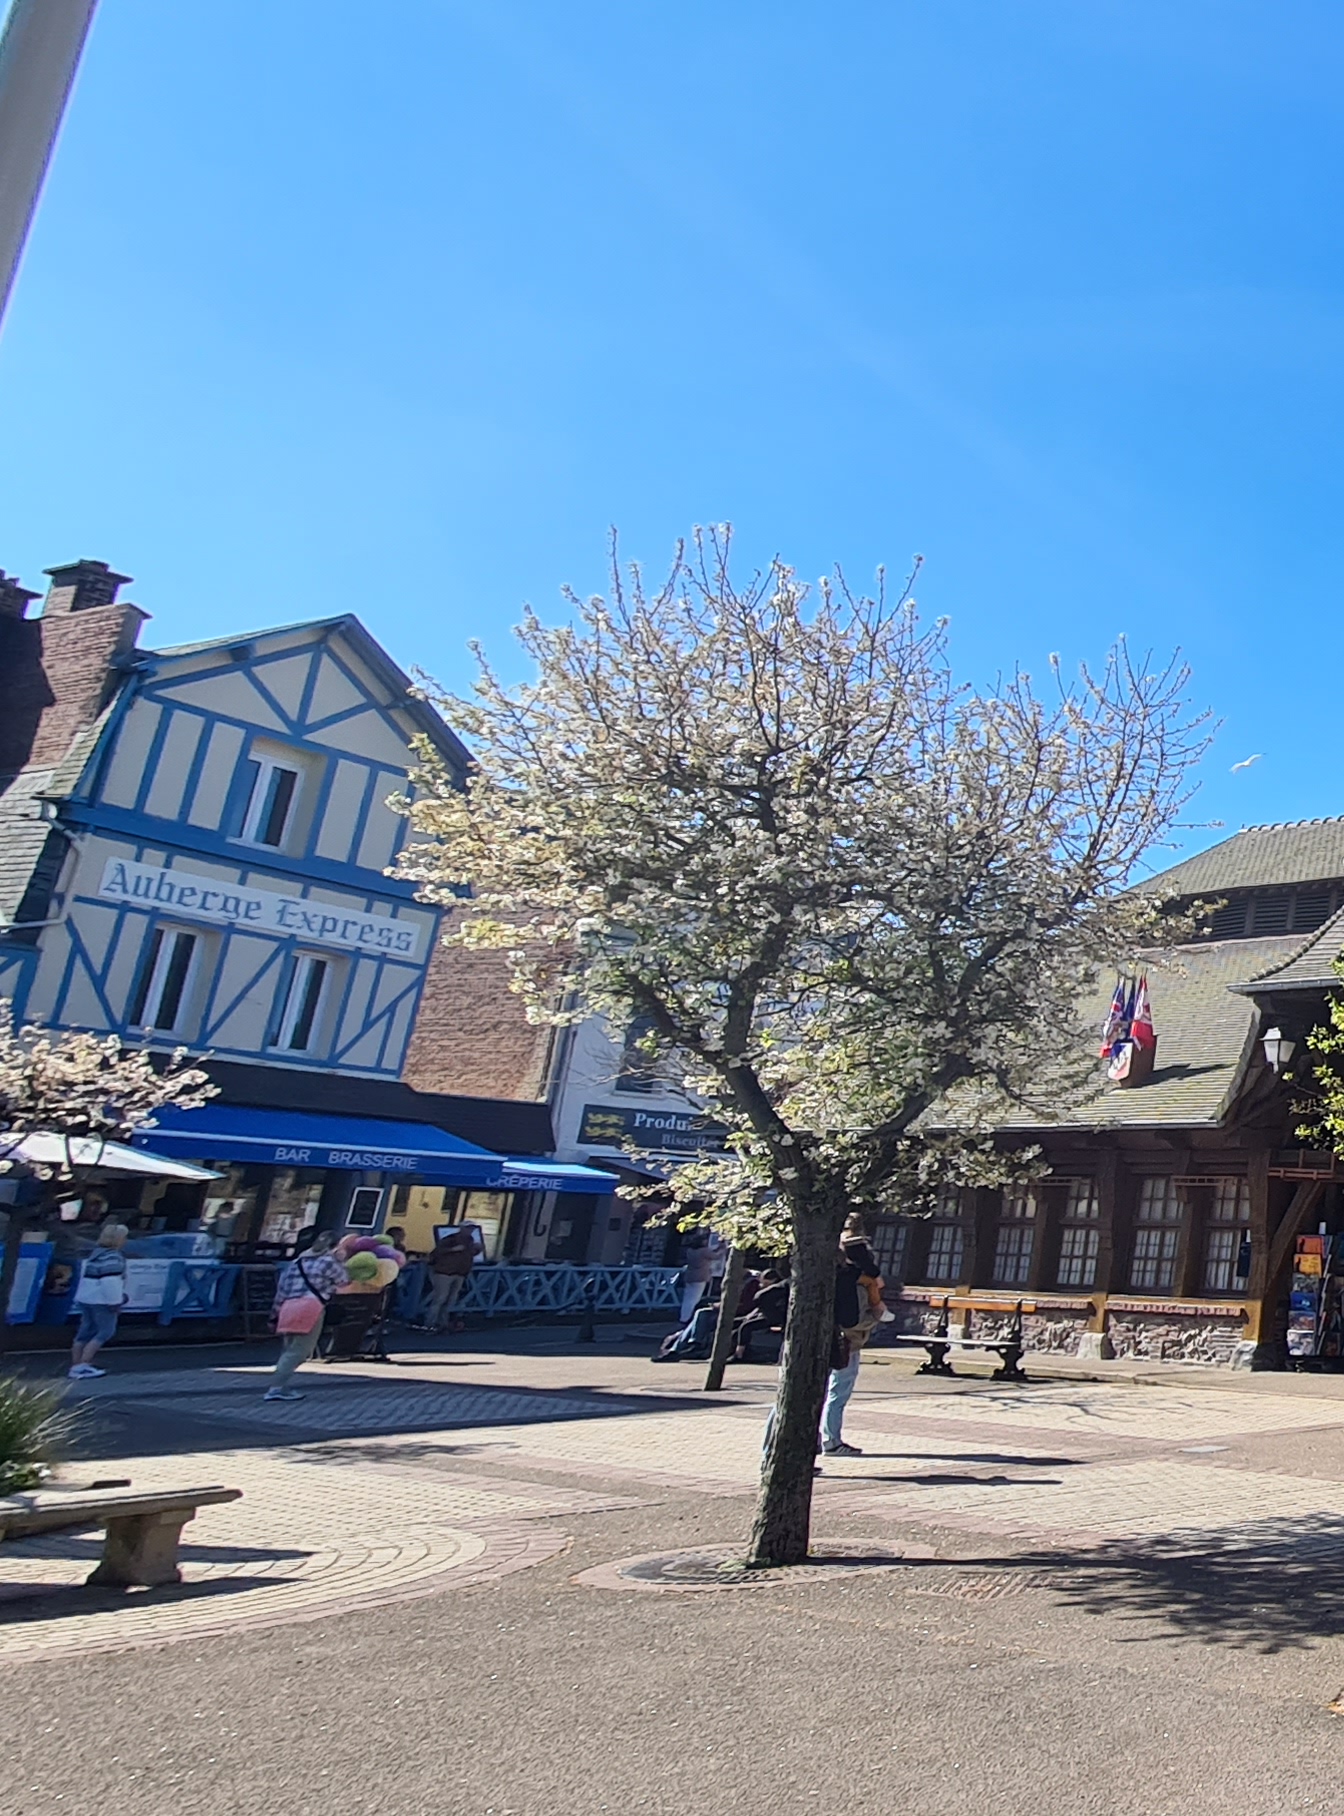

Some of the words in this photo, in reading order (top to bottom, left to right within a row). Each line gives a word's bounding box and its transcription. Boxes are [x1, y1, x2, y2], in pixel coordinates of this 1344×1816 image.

[103, 863, 262, 921] Auberge
[275, 898, 414, 951] Express
[634, 1112, 697, 1132] Produi
[275, 1147, 311, 1163] BAR
[328, 1150, 418, 1170] BRASSERIE
